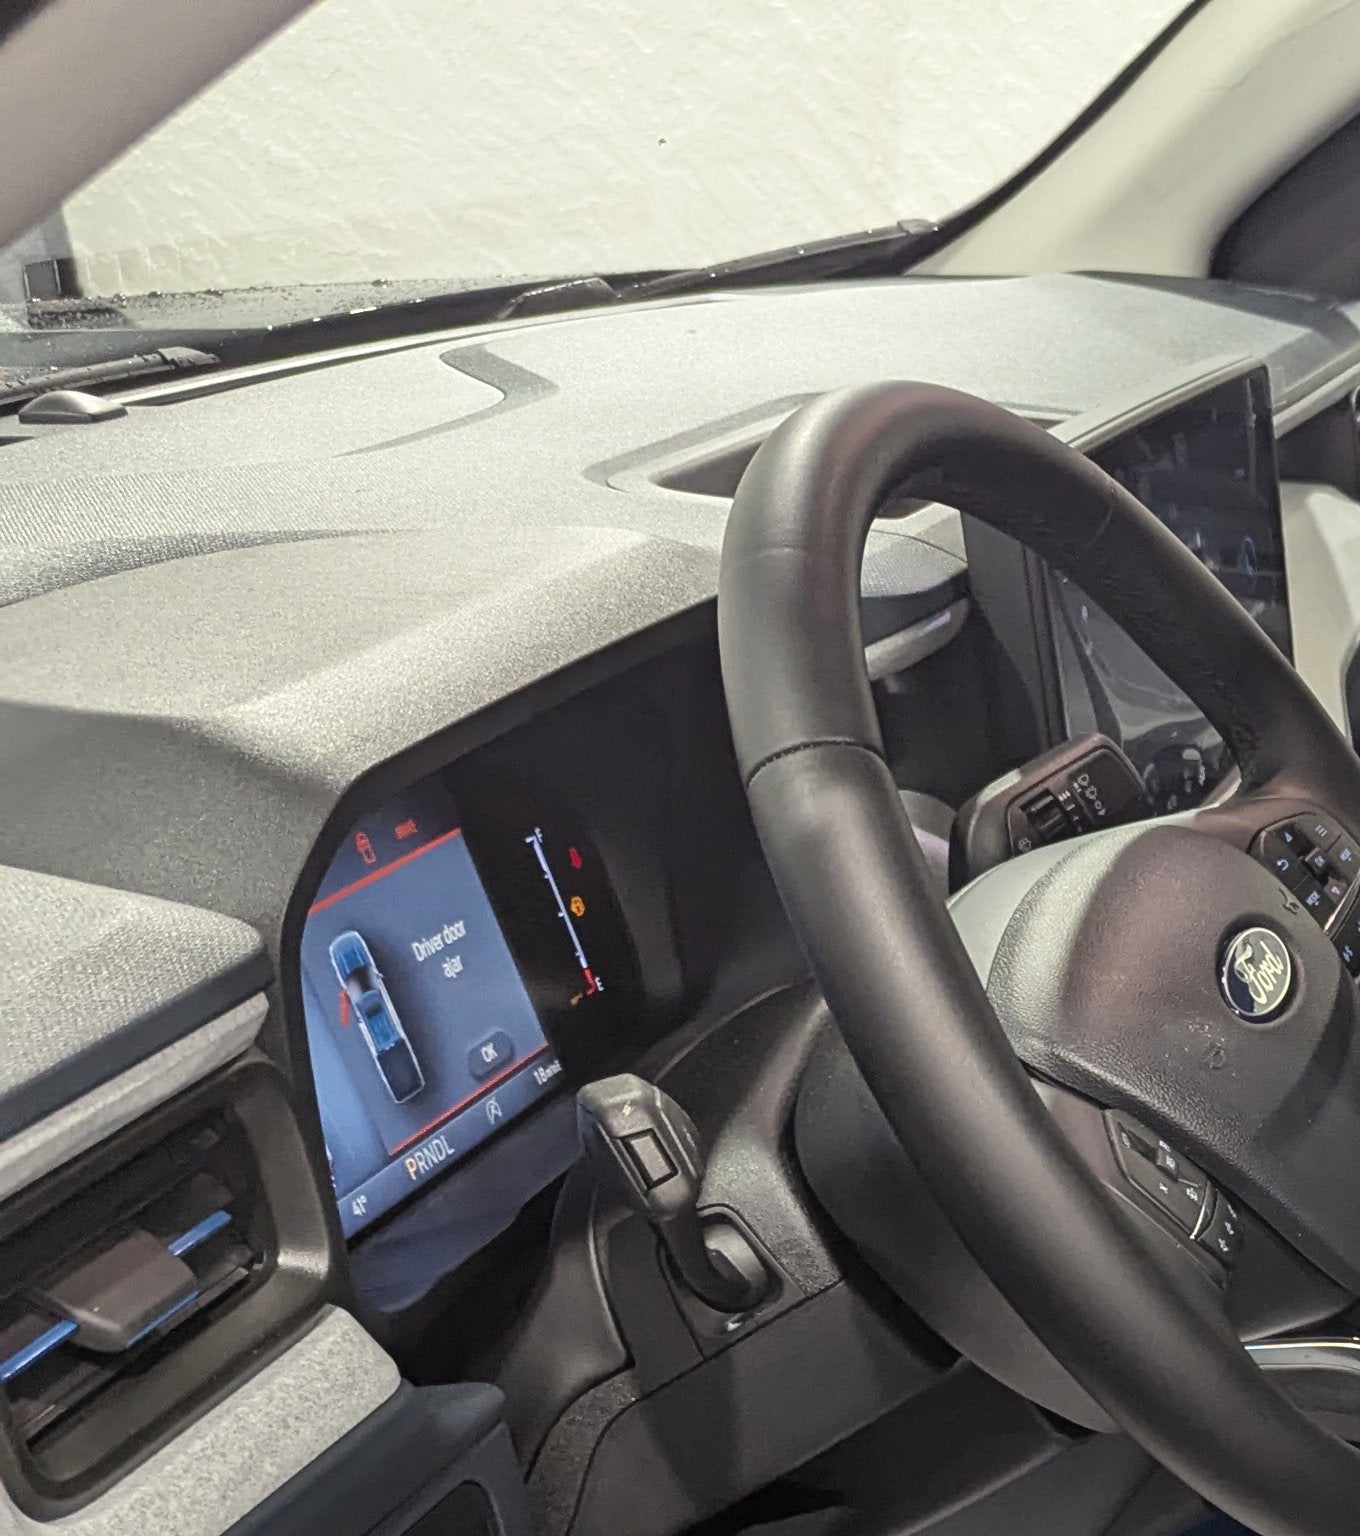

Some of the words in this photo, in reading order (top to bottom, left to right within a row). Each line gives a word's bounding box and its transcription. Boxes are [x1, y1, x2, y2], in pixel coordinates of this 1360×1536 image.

[412, 933, 445, 962] Driver
[443, 920, 466, 945] door
[442, 955, 464, 979] ajar
[1233, 940, 1284, 1005] Ford
[481, 1042, 498, 1063] OK
